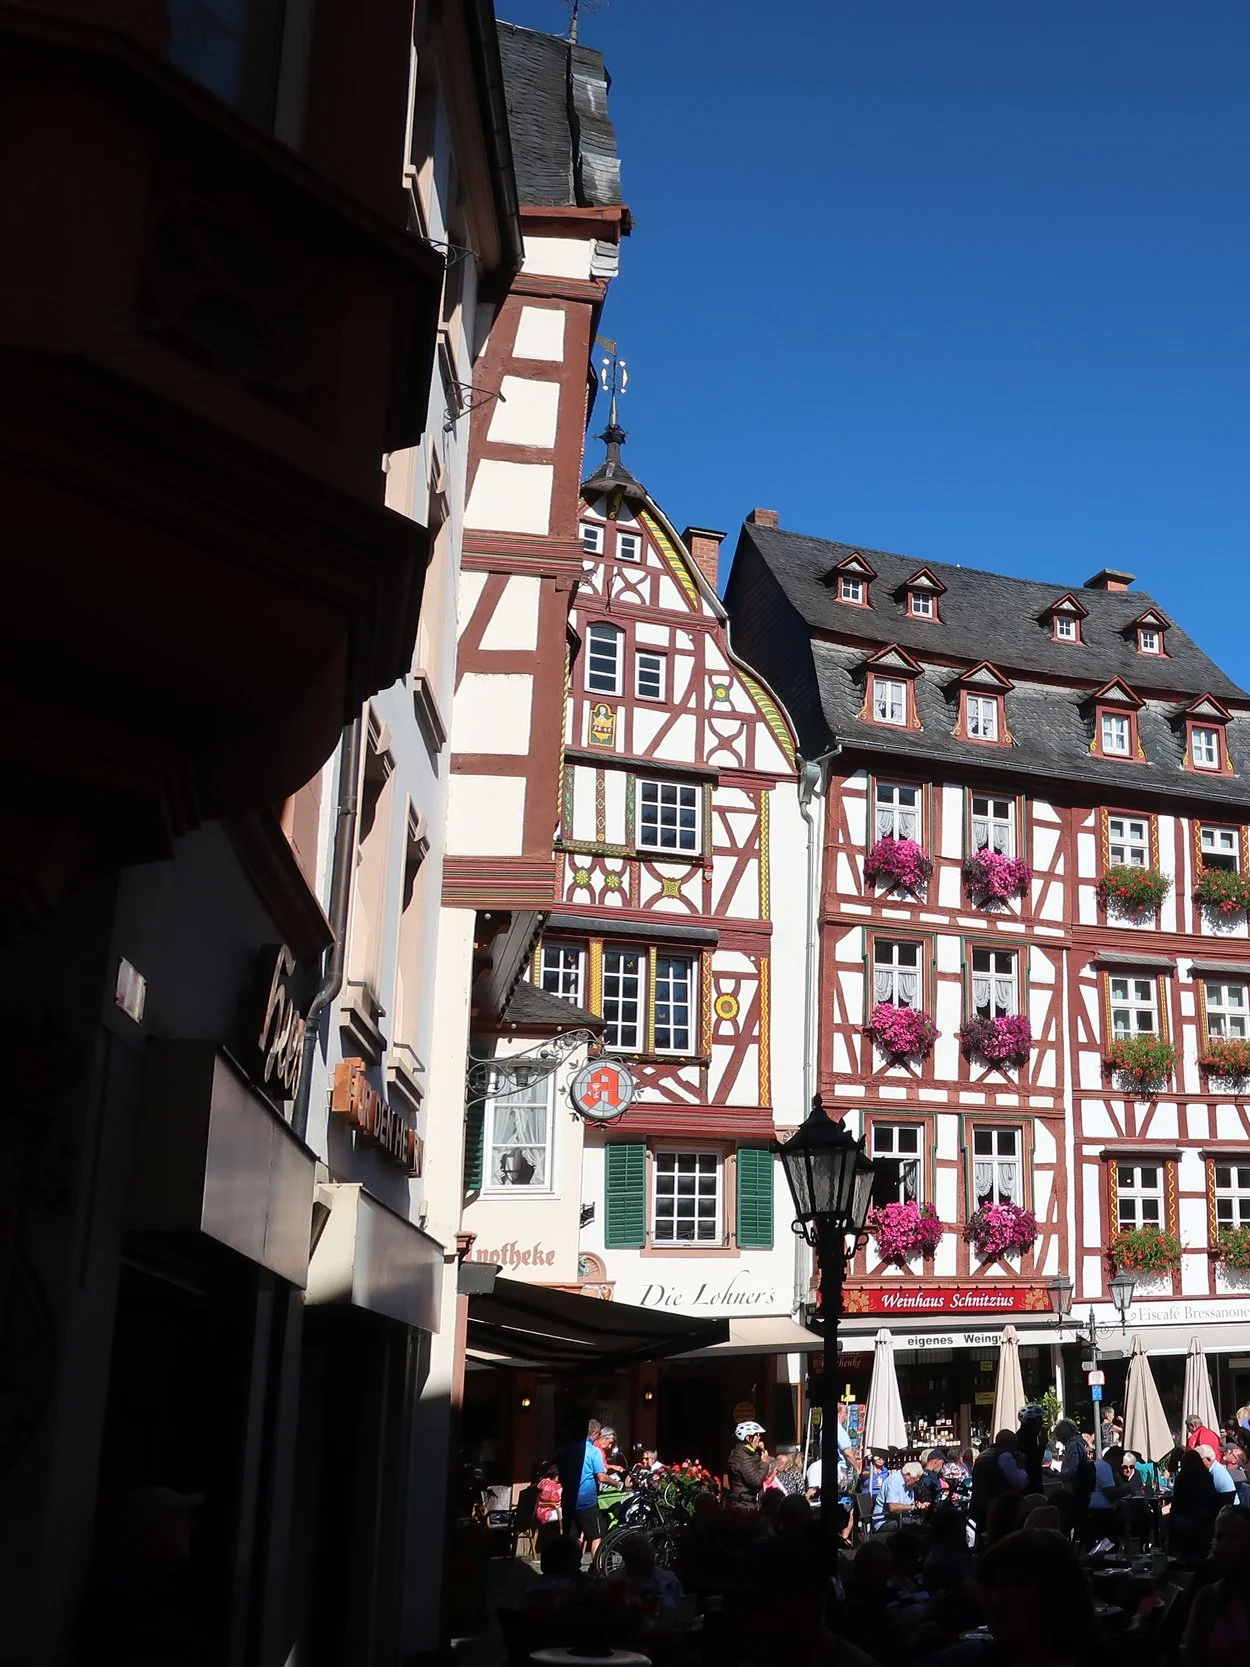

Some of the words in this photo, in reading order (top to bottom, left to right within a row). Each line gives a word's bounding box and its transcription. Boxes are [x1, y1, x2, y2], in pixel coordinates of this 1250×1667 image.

[638, 1283, 683, 1307] Die
[881, 1292, 944, 1308] Weinhaus
[950, 1291, 1014, 1308] Schnitzius
[907, 1335, 954, 1347] eigenes
